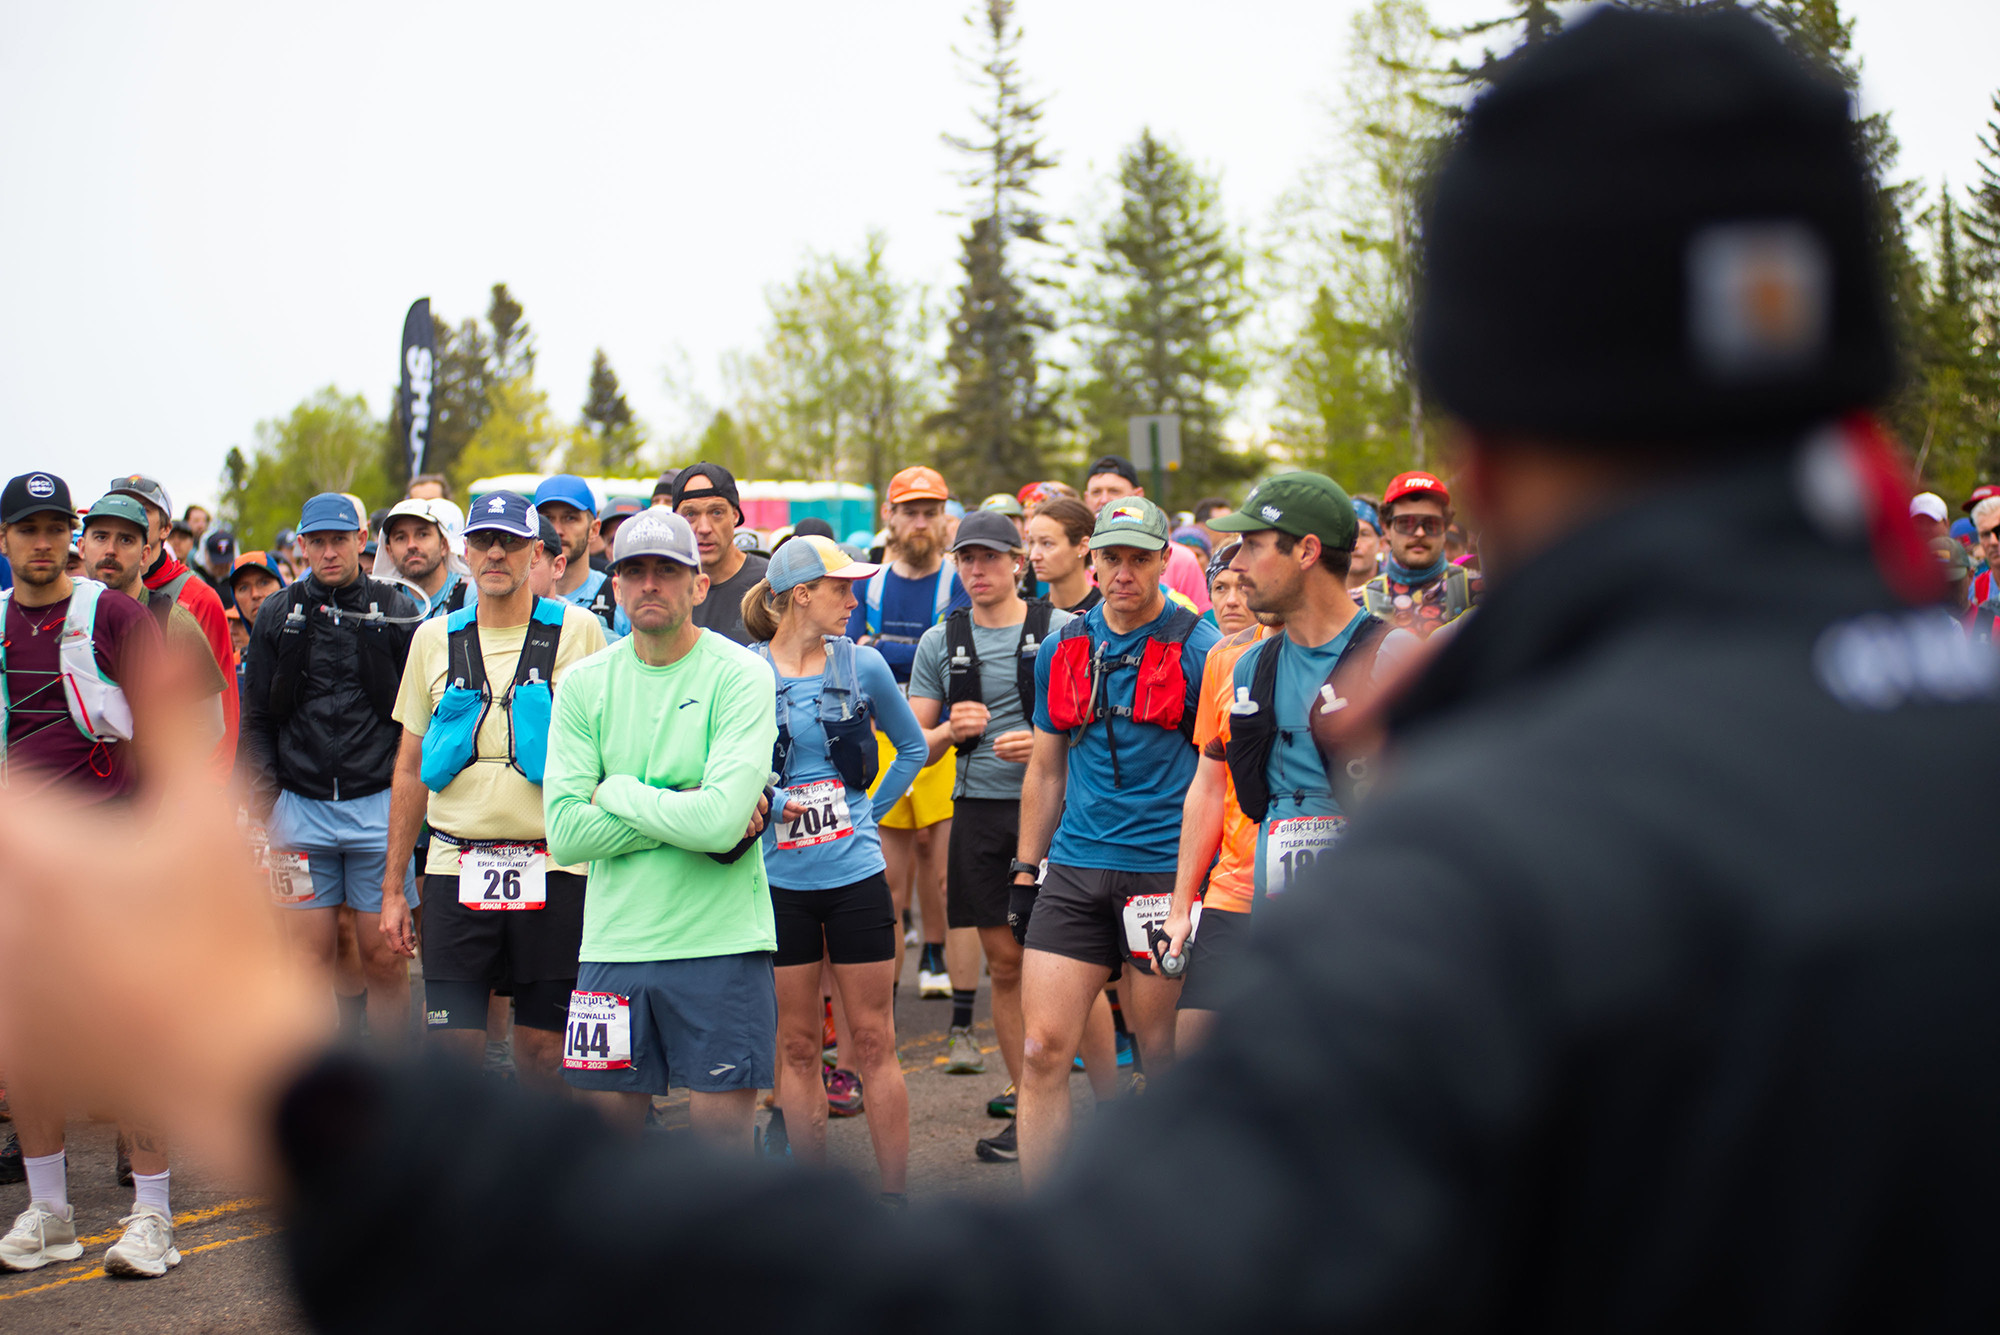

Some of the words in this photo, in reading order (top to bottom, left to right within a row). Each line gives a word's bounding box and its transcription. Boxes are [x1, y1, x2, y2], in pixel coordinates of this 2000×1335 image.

[789, 803, 839, 839] 204
[1280, 840, 1304, 849] TYLER
[483, 869, 521, 900] 26
[1137, 911, 1153, 919] DAN
[577, 1012, 616, 1020] KOWALLIS
[567, 1021, 610, 1058] 144
[587, 1061, 608, 1069] 2025
